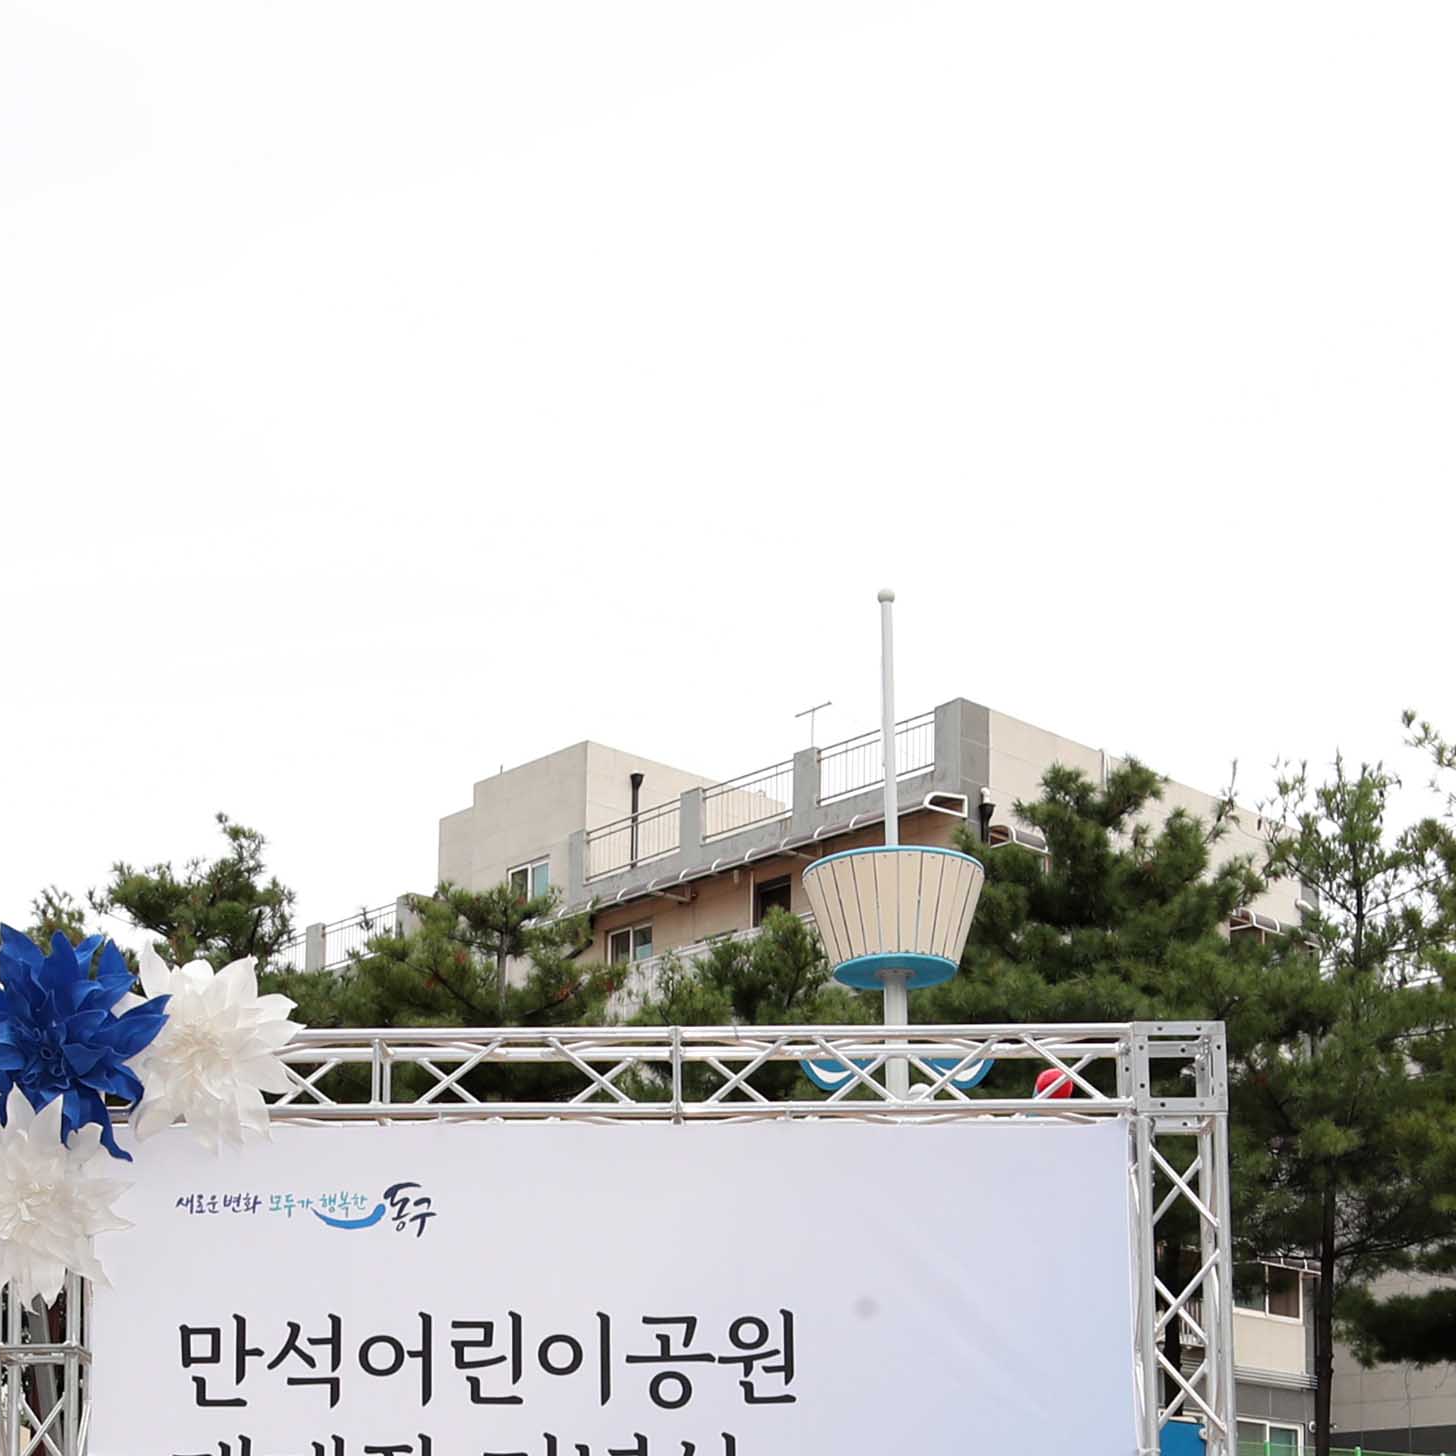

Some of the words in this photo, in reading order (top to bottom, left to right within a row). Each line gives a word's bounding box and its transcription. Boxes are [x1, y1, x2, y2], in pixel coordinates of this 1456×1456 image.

[175, 1193, 219, 1215] 새로운
[222, 1192, 262, 1215] 변화
[269, 1193, 312, 1218] 모두가
[319, 1191, 368, 1218] 행복한
[383, 1182, 437, 1238] 동구
[178, 1308, 797, 1410] 만석어린이공원
